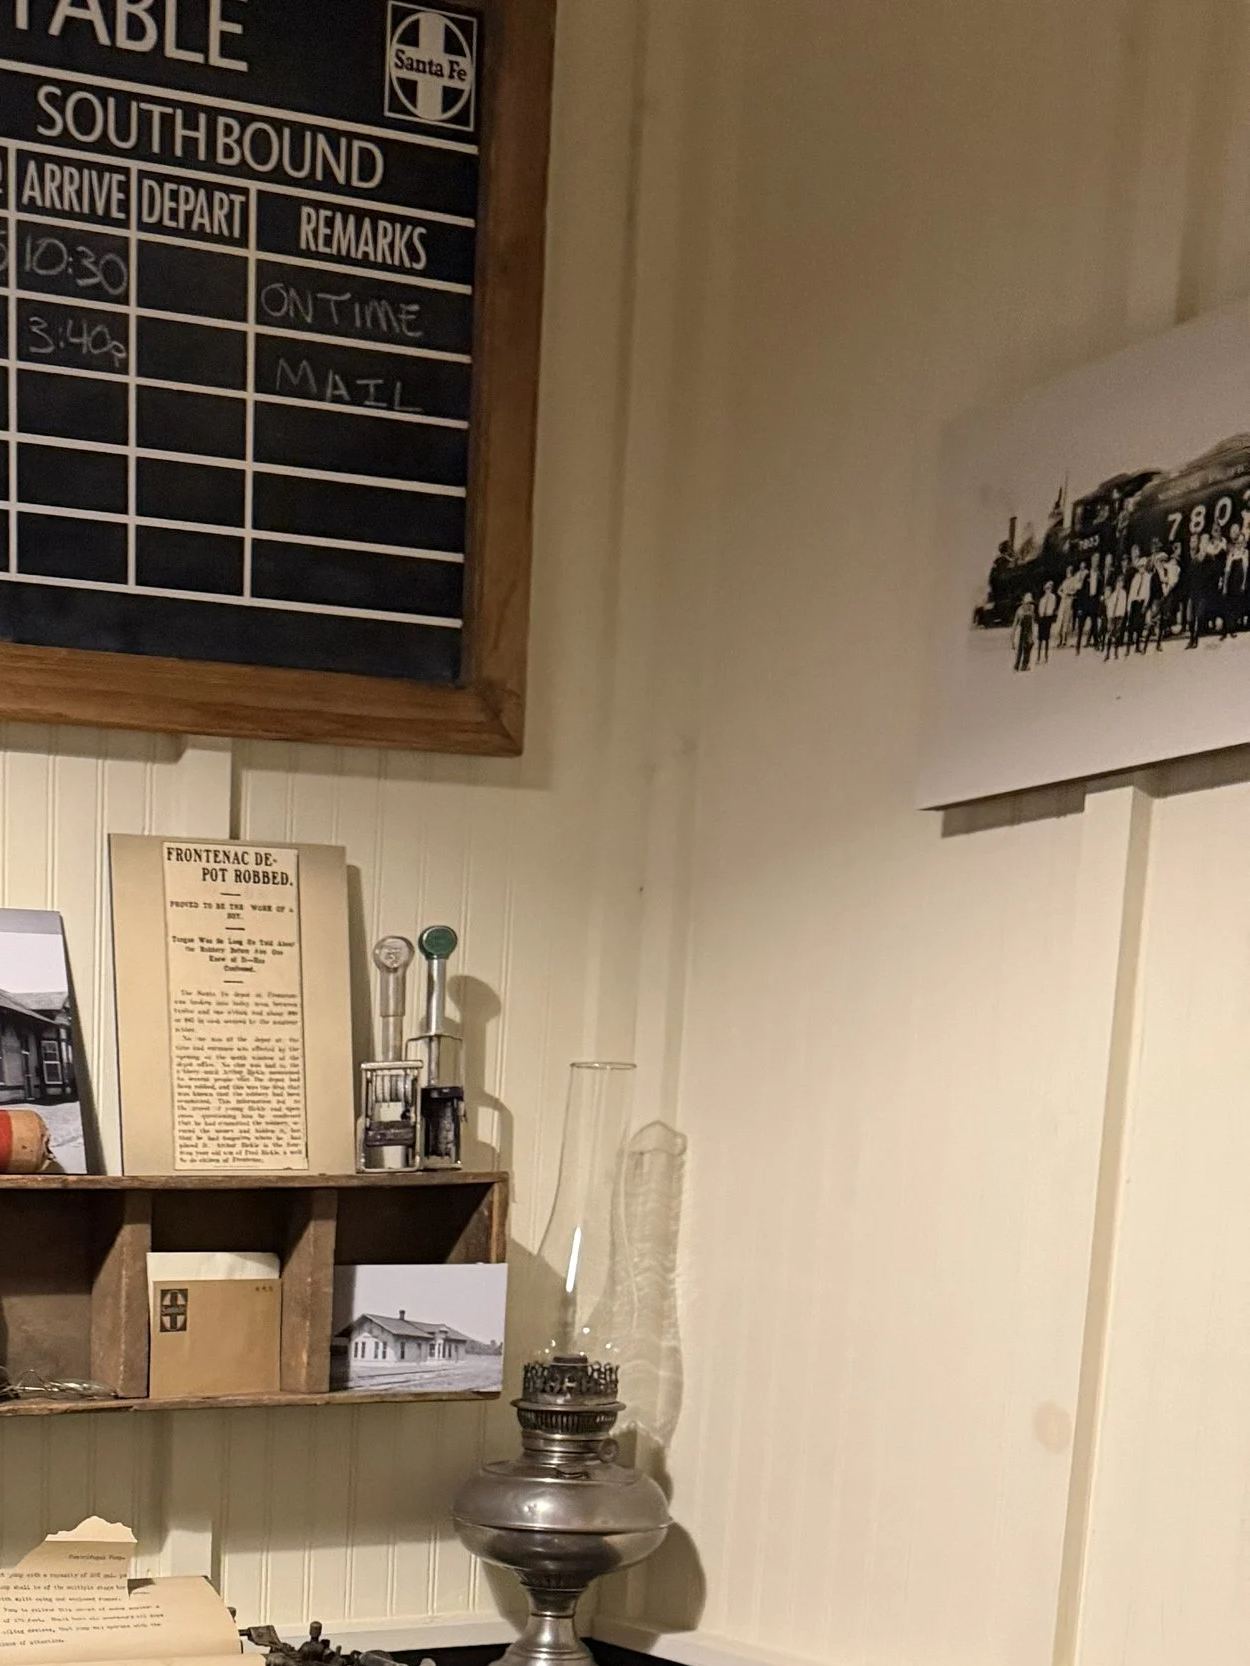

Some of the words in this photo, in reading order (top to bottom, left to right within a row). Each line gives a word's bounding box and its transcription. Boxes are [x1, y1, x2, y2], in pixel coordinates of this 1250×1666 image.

[394, 49, 443, 77] Santa
[447, 62, 468, 82] Fe
[36, 85, 384, 189] SOUTHBOUND
[22, 160, 126, 219] ARRIVE
[141, 179, 245, 238] DEPART
[301, 206, 427, 270] REMARKS
[25, 233, 128, 295] 10:30
[276, 358, 423, 412] MAIL
[166, 847, 249, 866] FRONTENAC
[255, 851, 278, 867] DE-
[202, 867, 228, 883] POT
[234, 869, 294, 887] ROBBED.
[170, 900, 199, 908] PROVED
[229, 903, 244, 911] THE
[251, 904, 273, 912] WORK
[229, 938, 243, 946] Long
